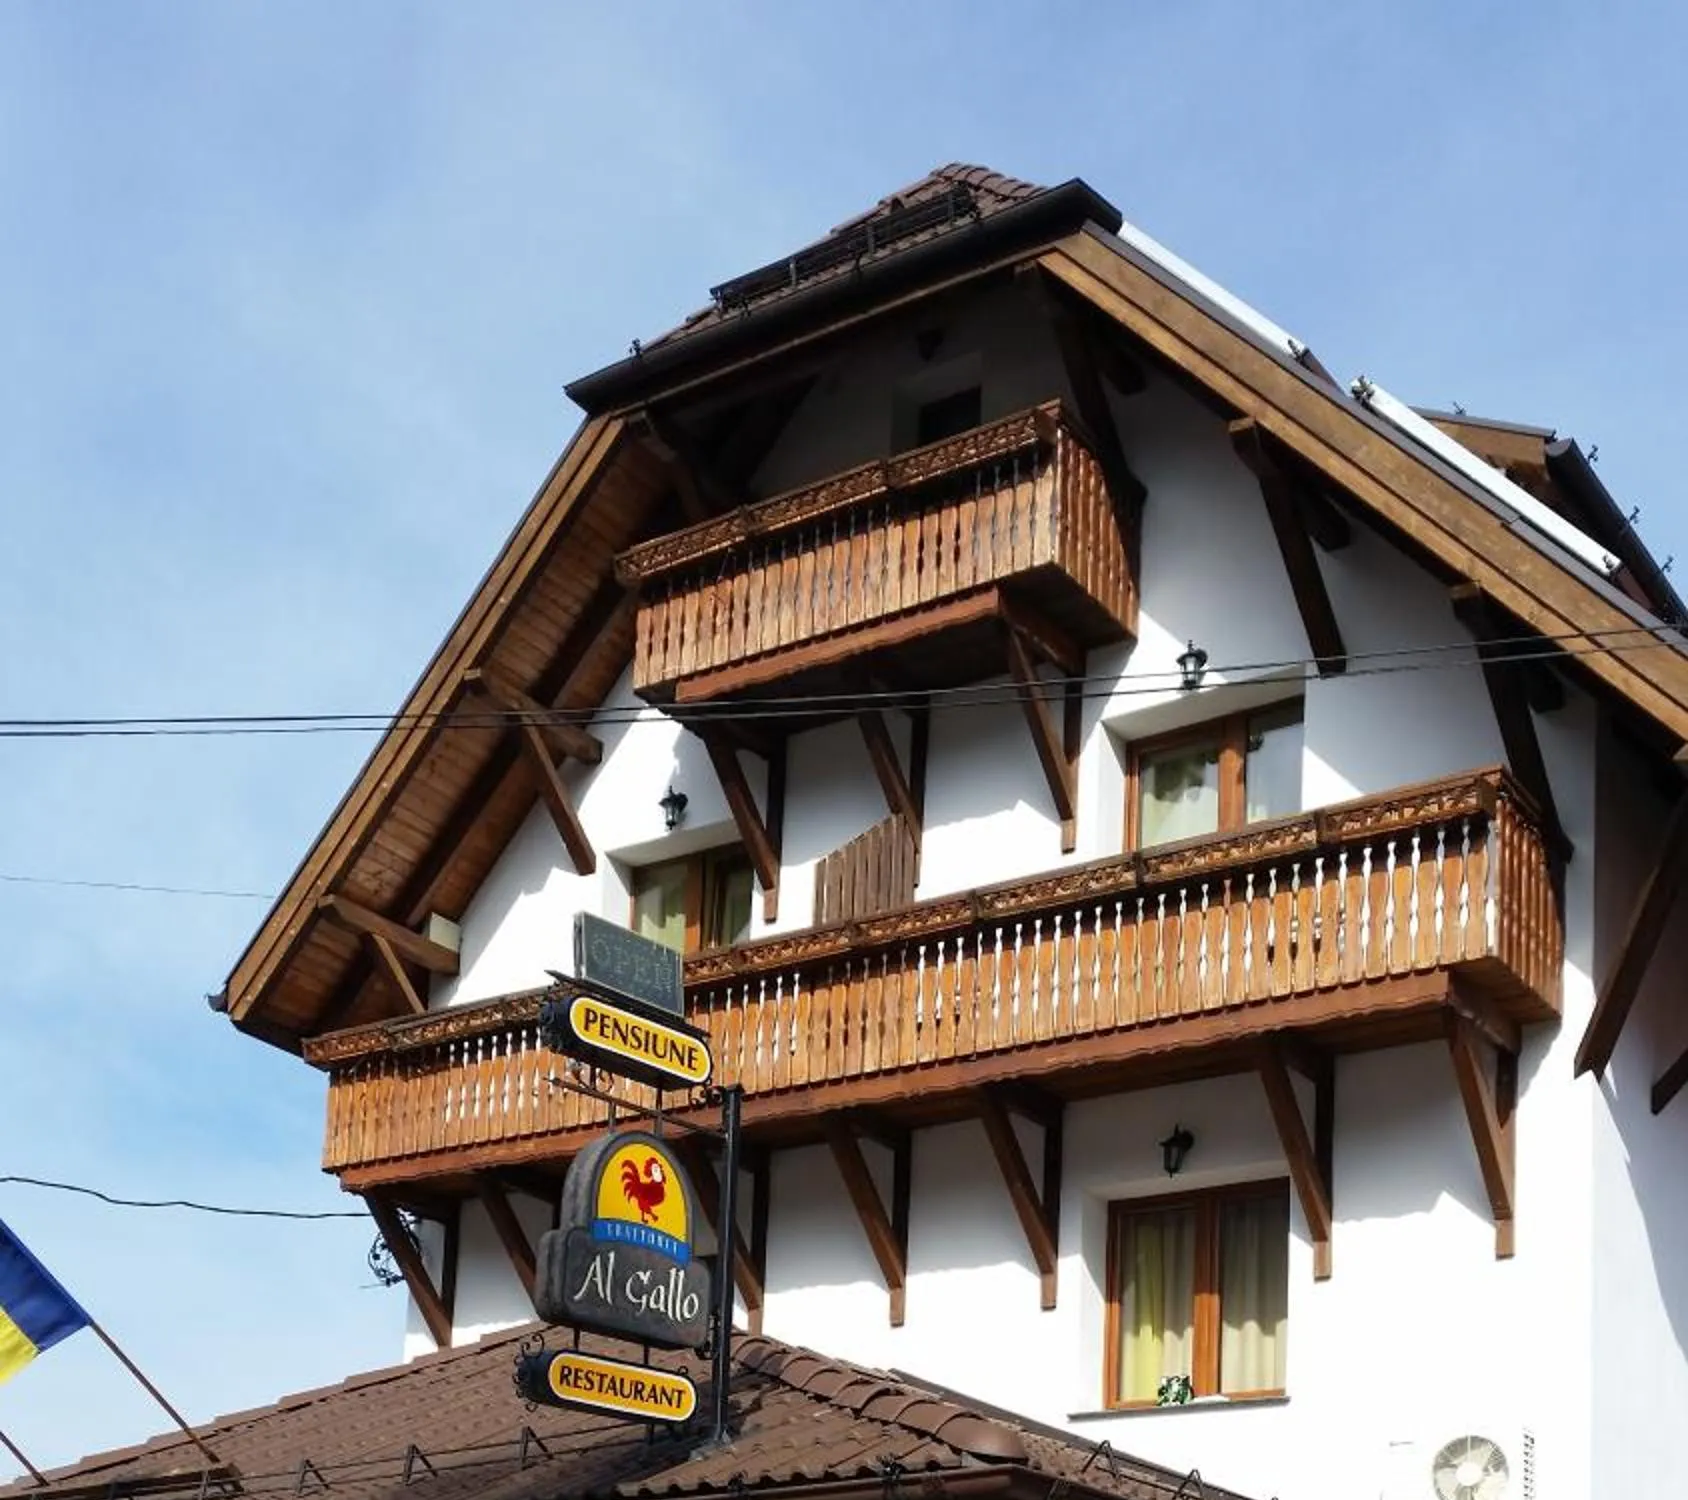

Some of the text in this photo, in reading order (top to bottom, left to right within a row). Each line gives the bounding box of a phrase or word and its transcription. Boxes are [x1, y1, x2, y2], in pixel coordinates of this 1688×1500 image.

[583, 1007, 699, 1071] PENSIUNE
[573, 1250, 699, 1322] Al Gallo
[559, 1365, 686, 1409] RESTAURANT
